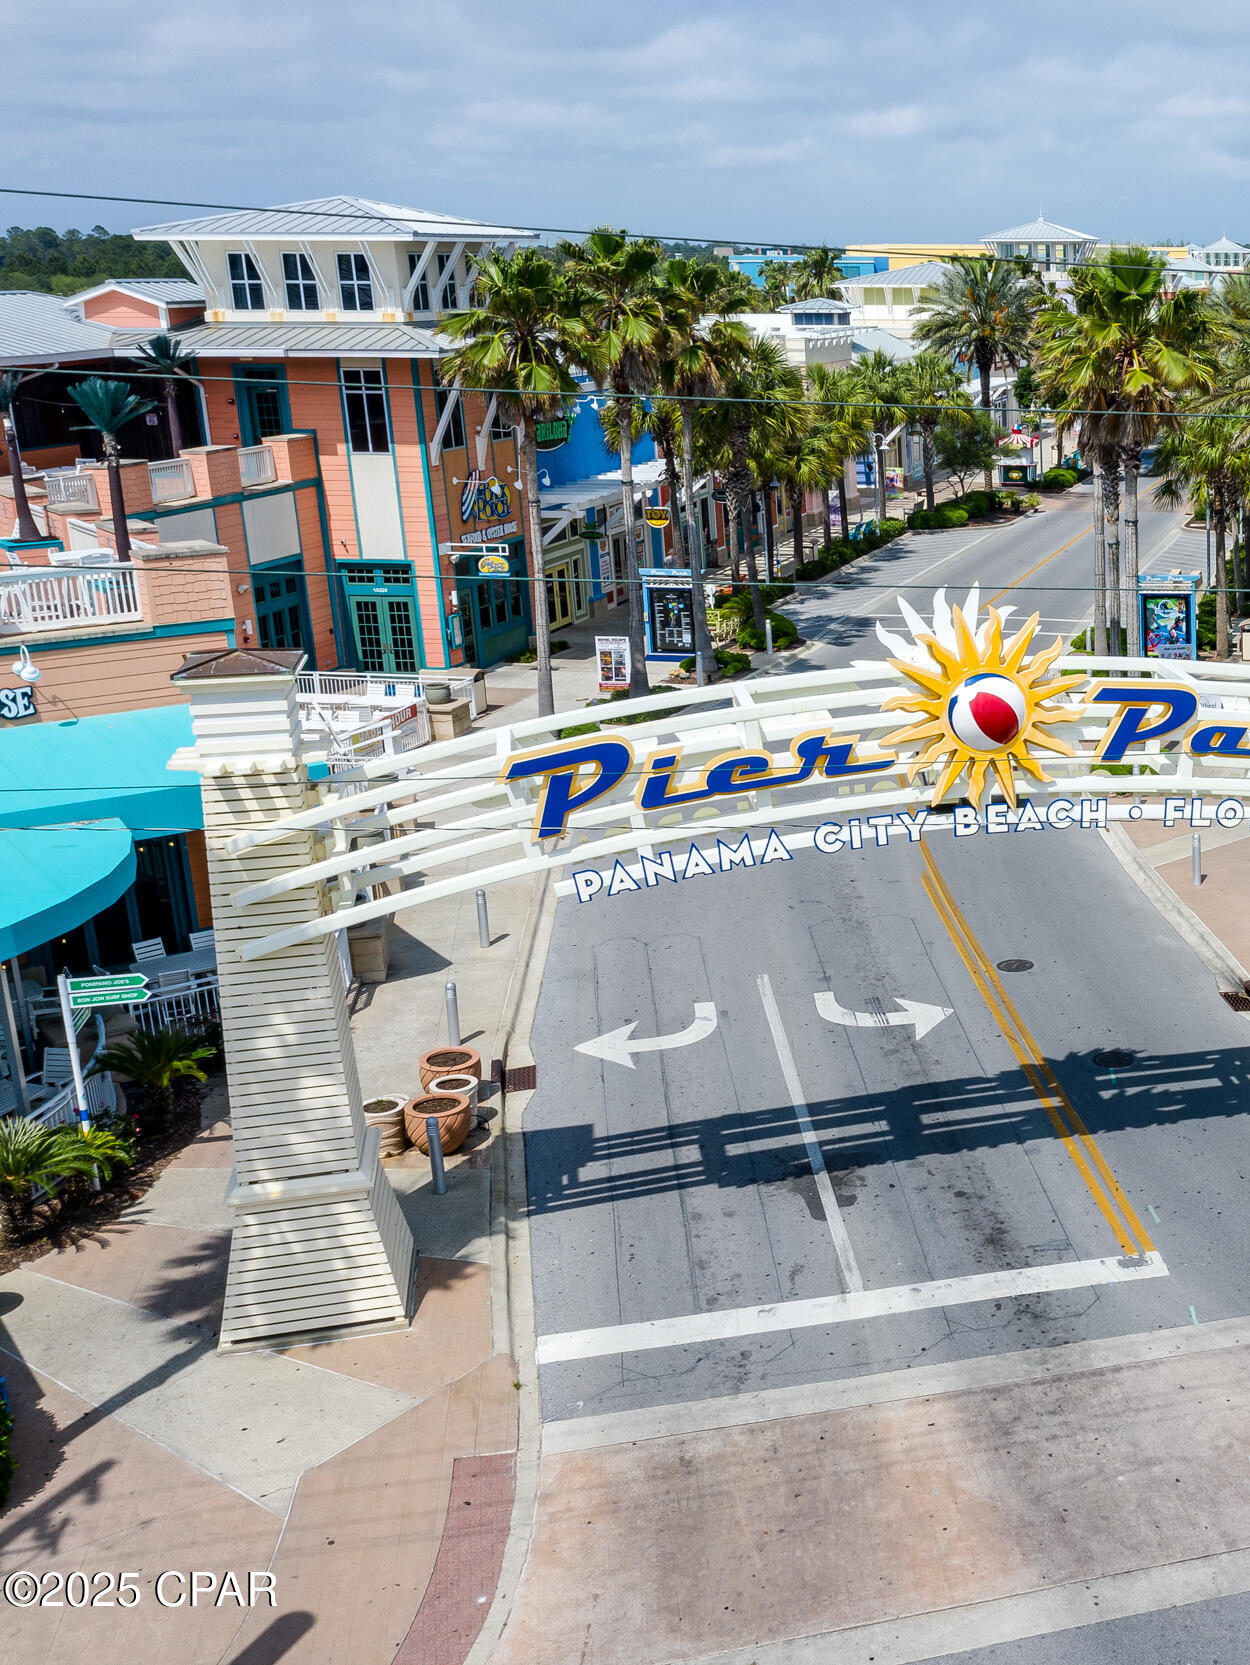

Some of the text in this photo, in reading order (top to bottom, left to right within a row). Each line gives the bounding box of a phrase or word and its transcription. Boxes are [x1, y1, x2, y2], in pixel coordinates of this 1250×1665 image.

[645, 509, 668, 520] TOY
[0, 686, 36, 718] SE
[496, 727, 899, 842] Pier
[572, 827, 794, 904] PANAMA
[813, 808, 931, 854] CITY
[953, 798, 1108, 838] BEACH
